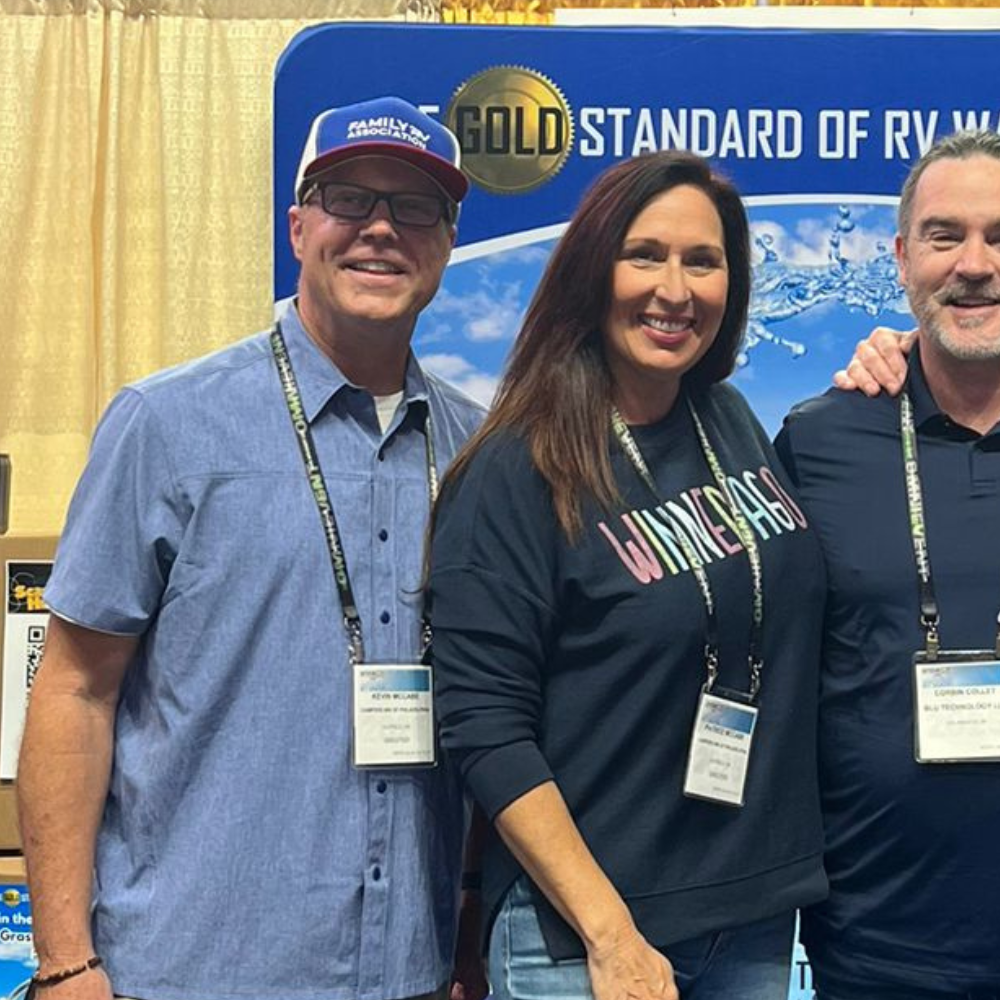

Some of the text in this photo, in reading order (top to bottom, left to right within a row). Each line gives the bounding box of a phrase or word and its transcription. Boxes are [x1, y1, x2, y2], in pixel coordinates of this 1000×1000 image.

[348, 116, 408, 132] FAMILY
[455, 106, 565, 155] GOLD
[579, 107, 803, 159] STANDARD
[818, 109, 871, 160] OF
[884, 109, 939, 160] RV
[347, 127, 427, 150] ASSOCIATION
